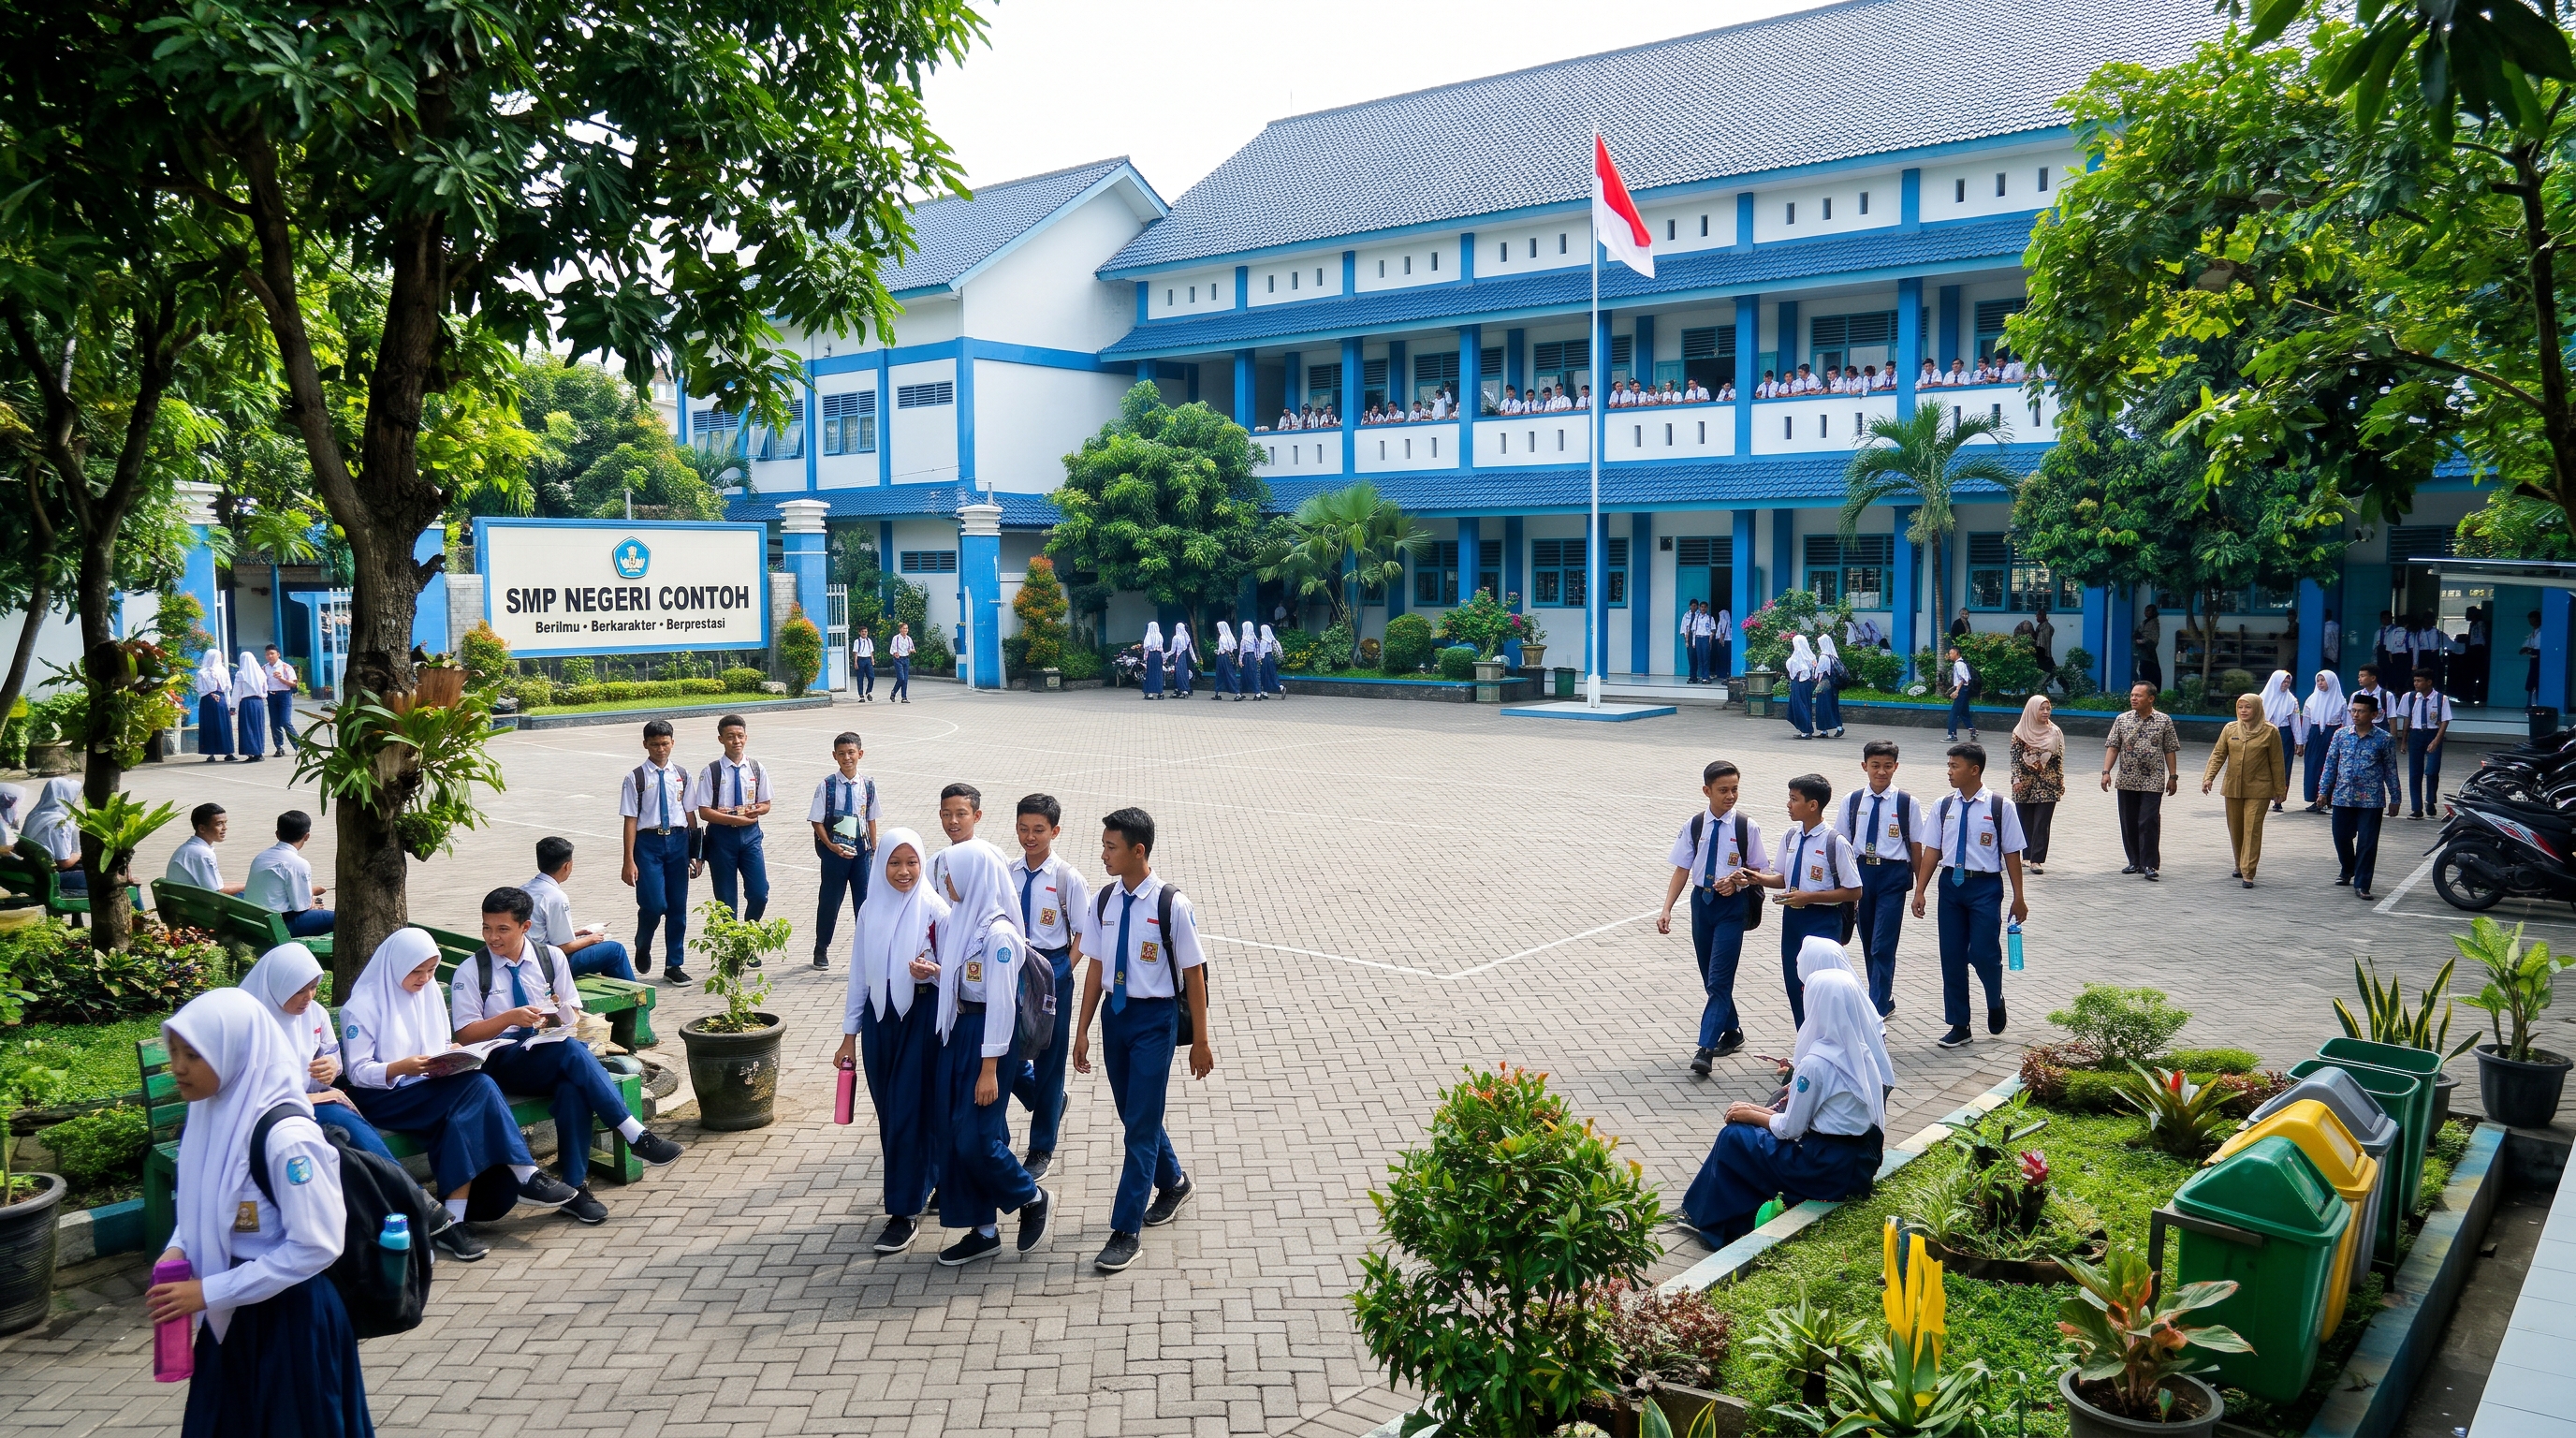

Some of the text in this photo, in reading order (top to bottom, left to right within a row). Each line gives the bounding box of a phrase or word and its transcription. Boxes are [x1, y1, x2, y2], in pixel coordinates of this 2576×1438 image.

[505, 585, 750, 614] SMP NEGERI CONTOH
[535, 617, 725, 634] Berilmu Berkarakter Berprestasi
